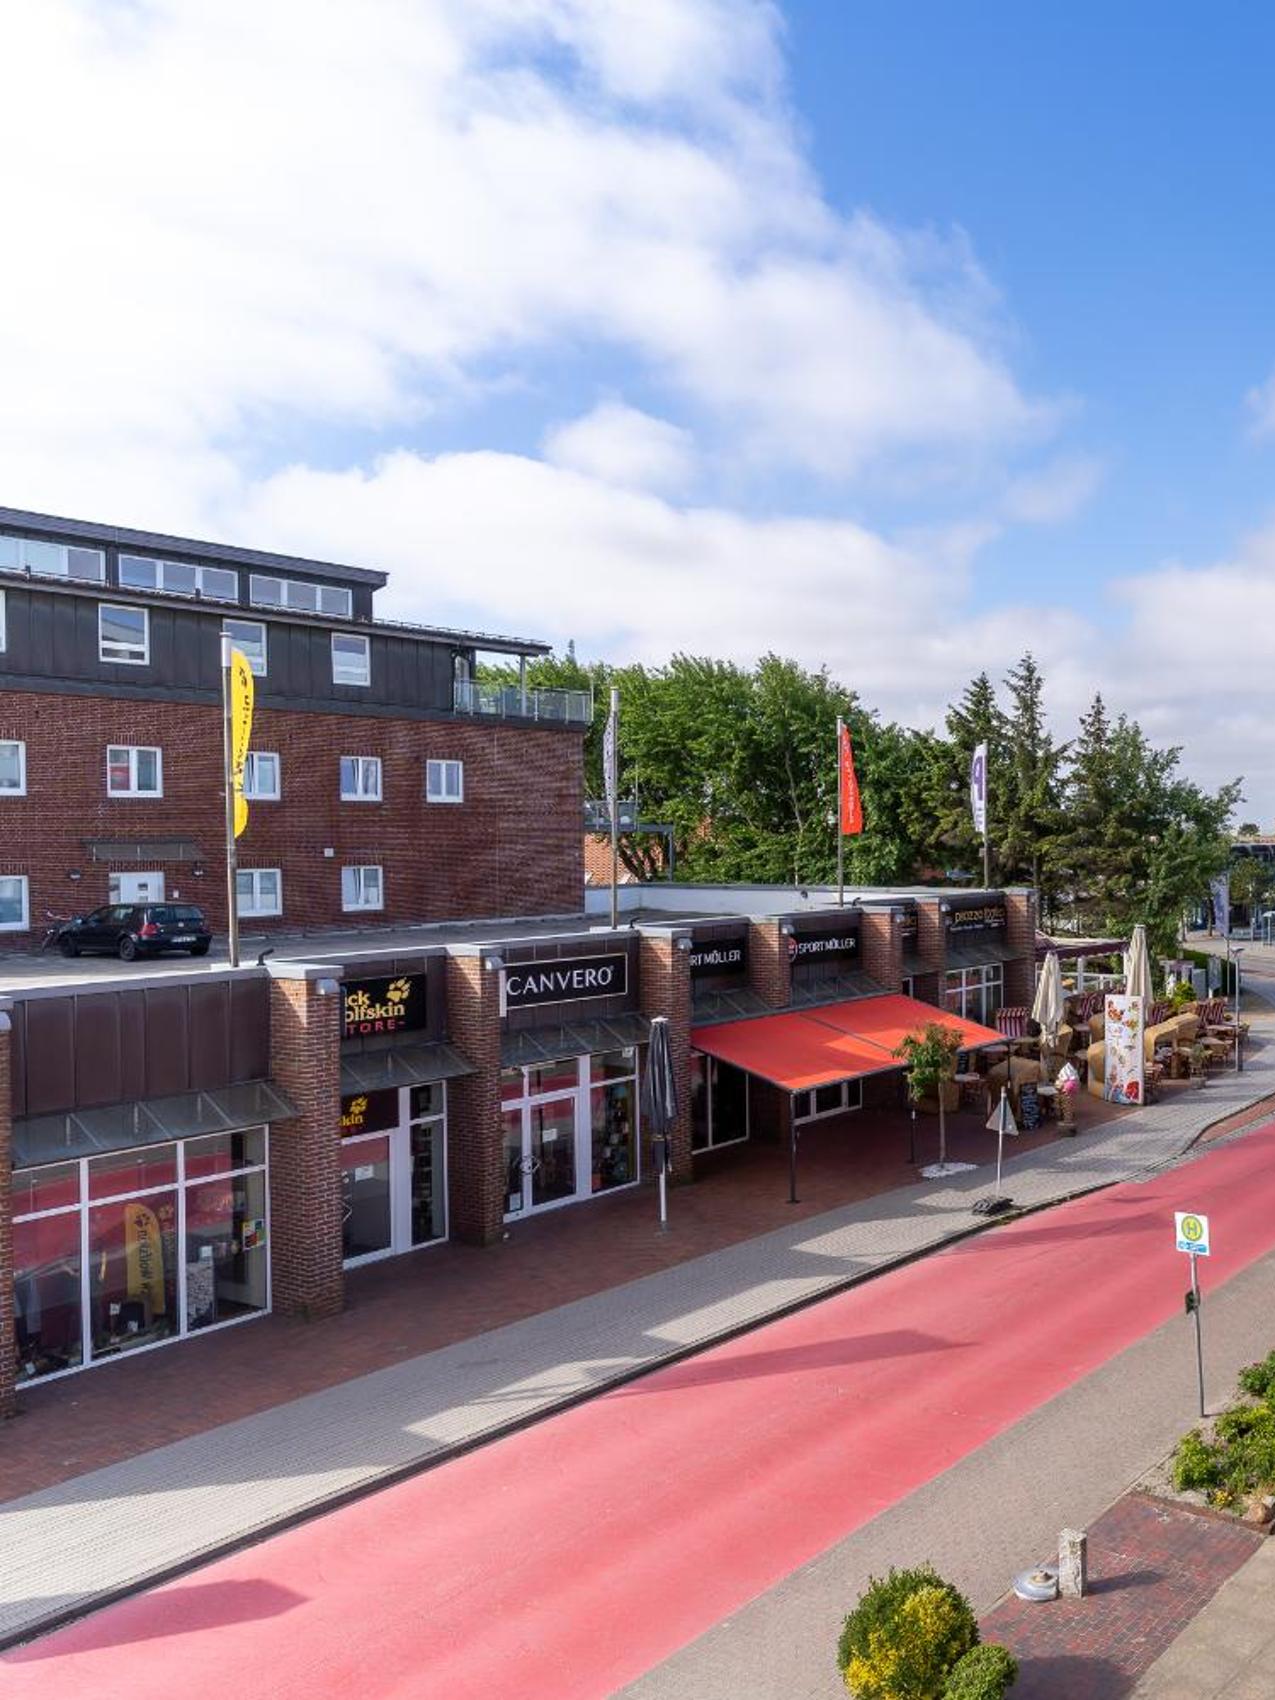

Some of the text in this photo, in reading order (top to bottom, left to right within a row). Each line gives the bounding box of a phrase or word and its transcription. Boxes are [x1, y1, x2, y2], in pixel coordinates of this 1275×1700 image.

[799, 938, 856, 954] SPORT MÖLLER
[703, 949, 741, 965] MÖLLER
